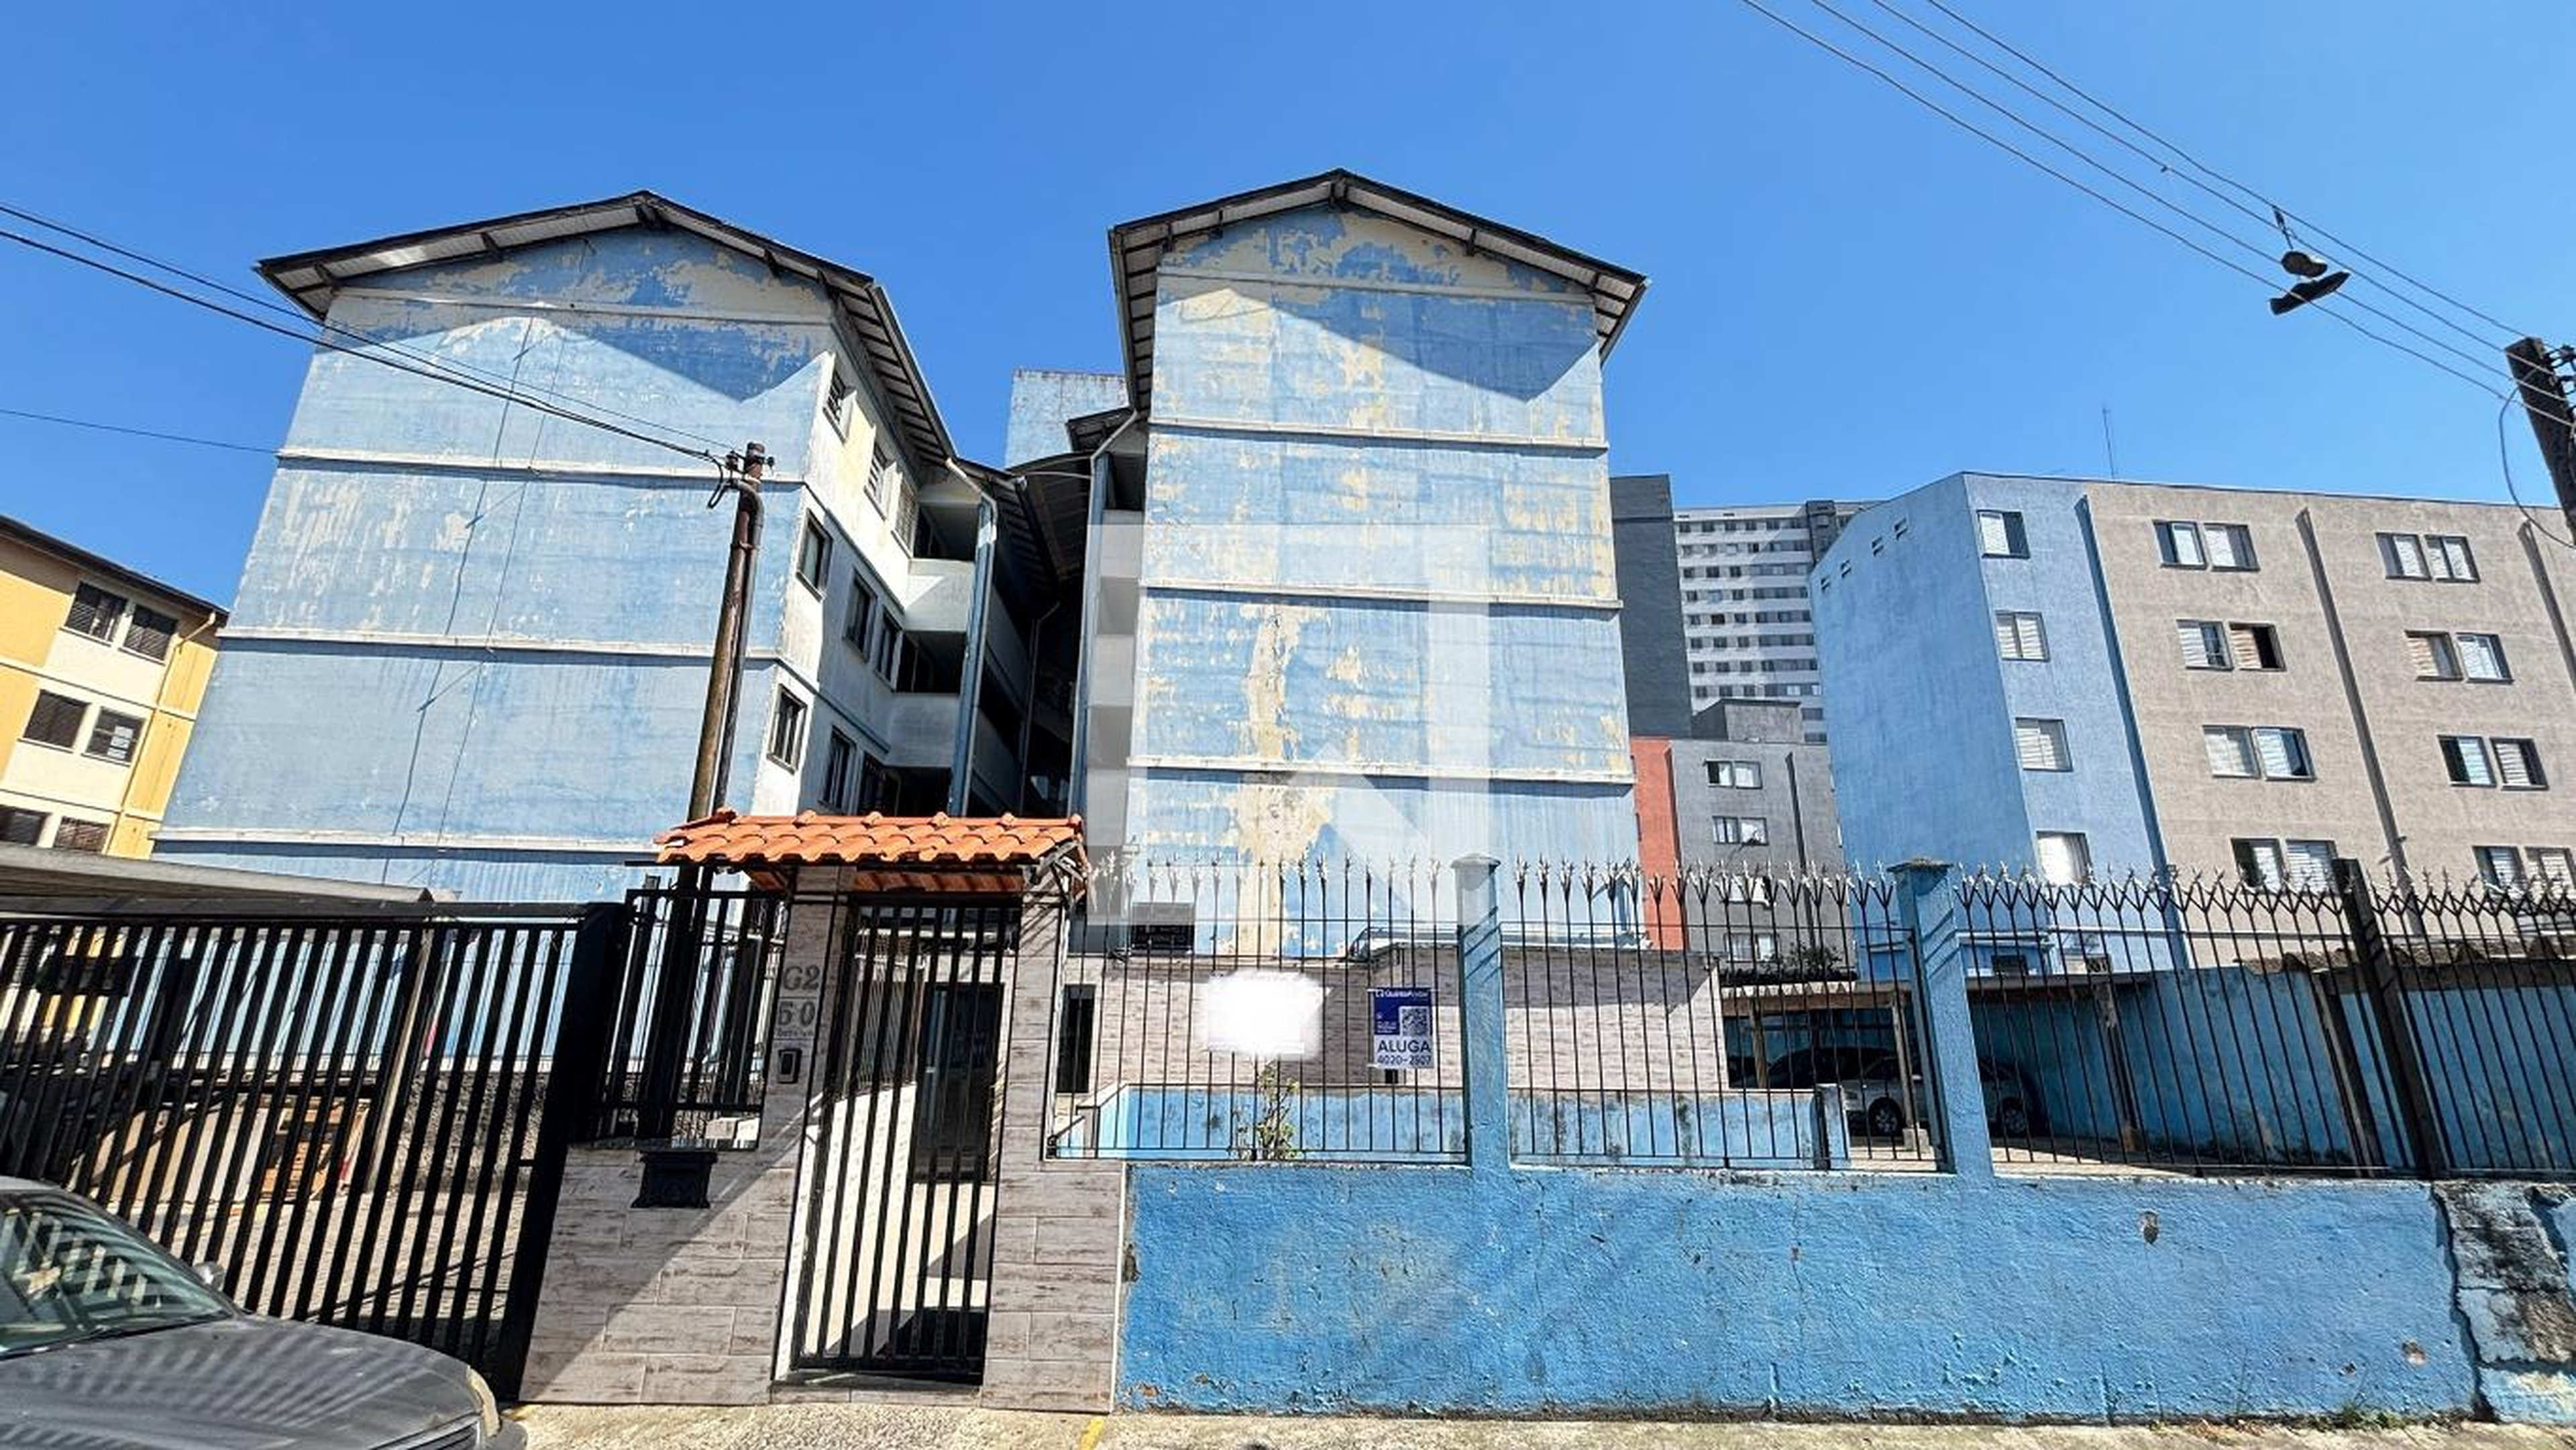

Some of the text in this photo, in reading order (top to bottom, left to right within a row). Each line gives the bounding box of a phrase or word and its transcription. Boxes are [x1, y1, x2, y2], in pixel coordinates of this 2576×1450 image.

[784, 965, 820, 990] G2
[777, 1001, 816, 1027] 50
[1377, 1039, 1431, 1053] ALUGA
